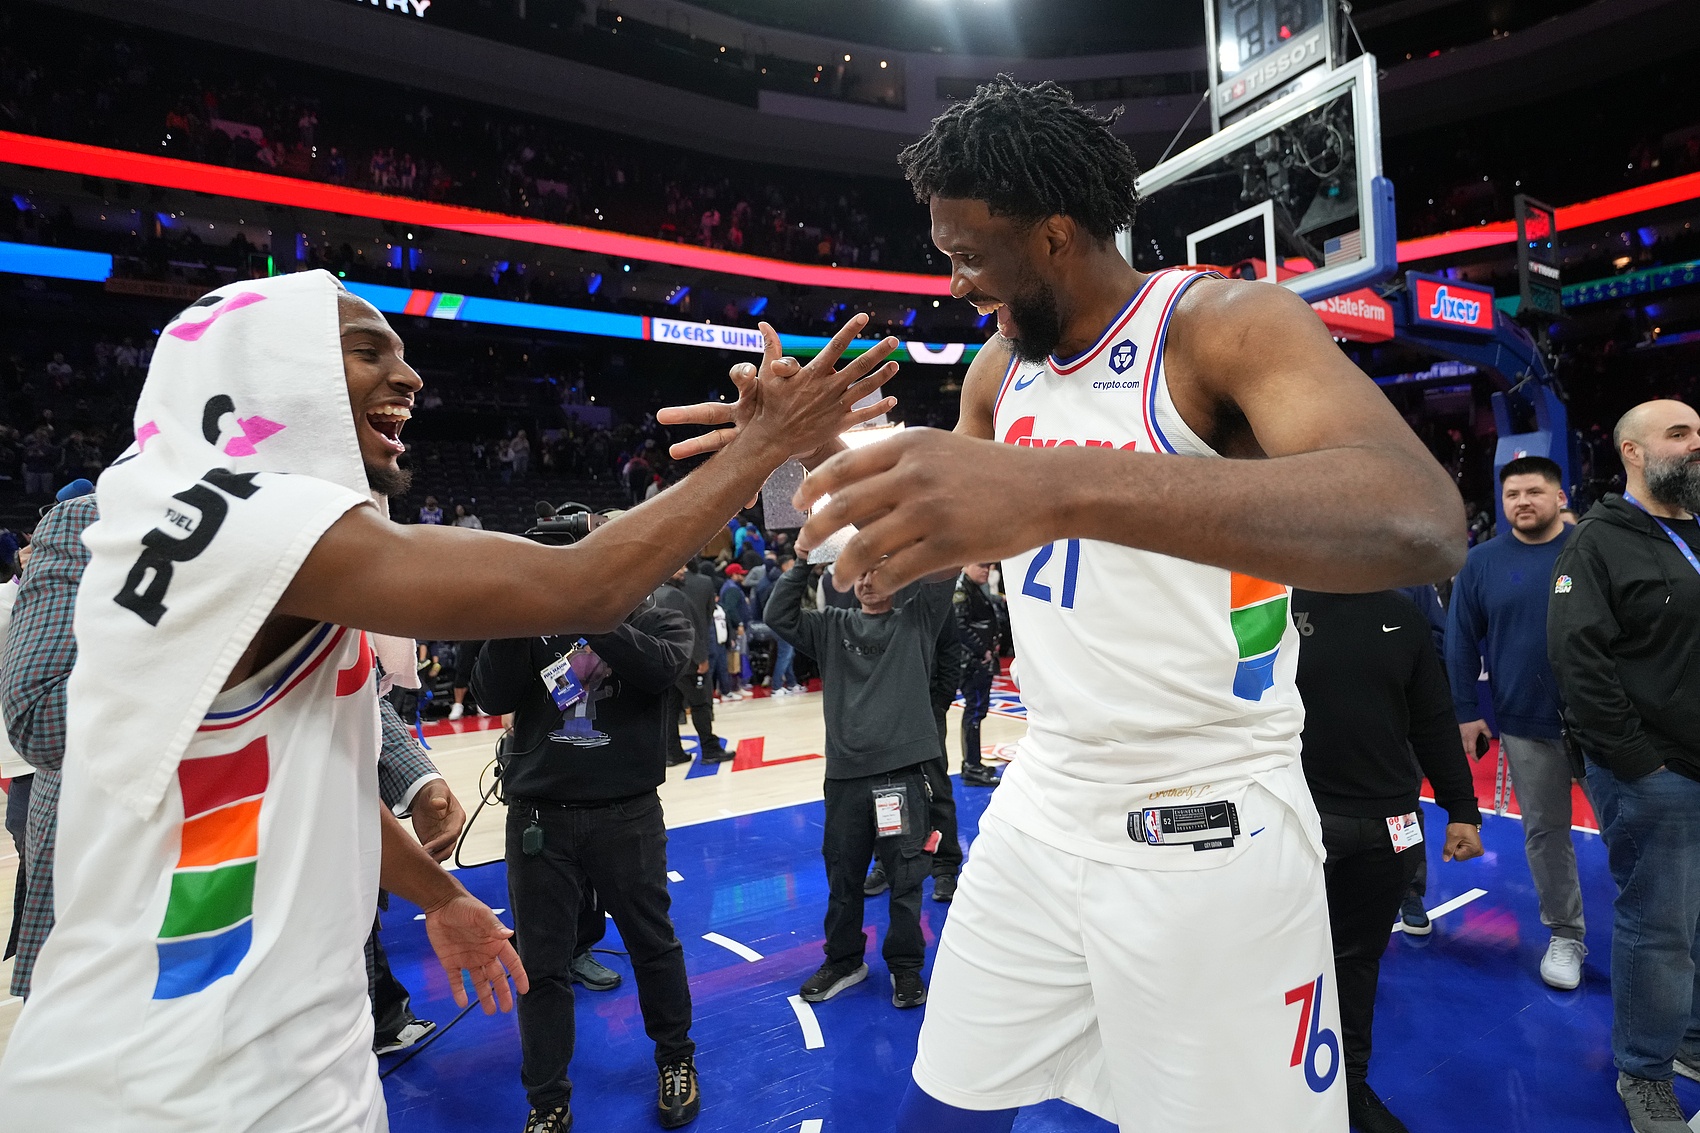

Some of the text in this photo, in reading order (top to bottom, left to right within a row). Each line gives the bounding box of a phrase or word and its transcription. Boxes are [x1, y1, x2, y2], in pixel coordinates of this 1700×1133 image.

[1245, 34, 1320, 90] TISSOT
[1430, 285, 1481, 325] Sixers
[661, 323, 715, 343] 76ERS
[1092, 379, 1140, 391] crypto.com
[165, 507, 195, 533] FUEL
[1020, 537, 1082, 610] 21
[1293, 612, 1315, 637] 76
[1163, 817, 1172, 825] 52
[1284, 972, 1340, 1094] 76
